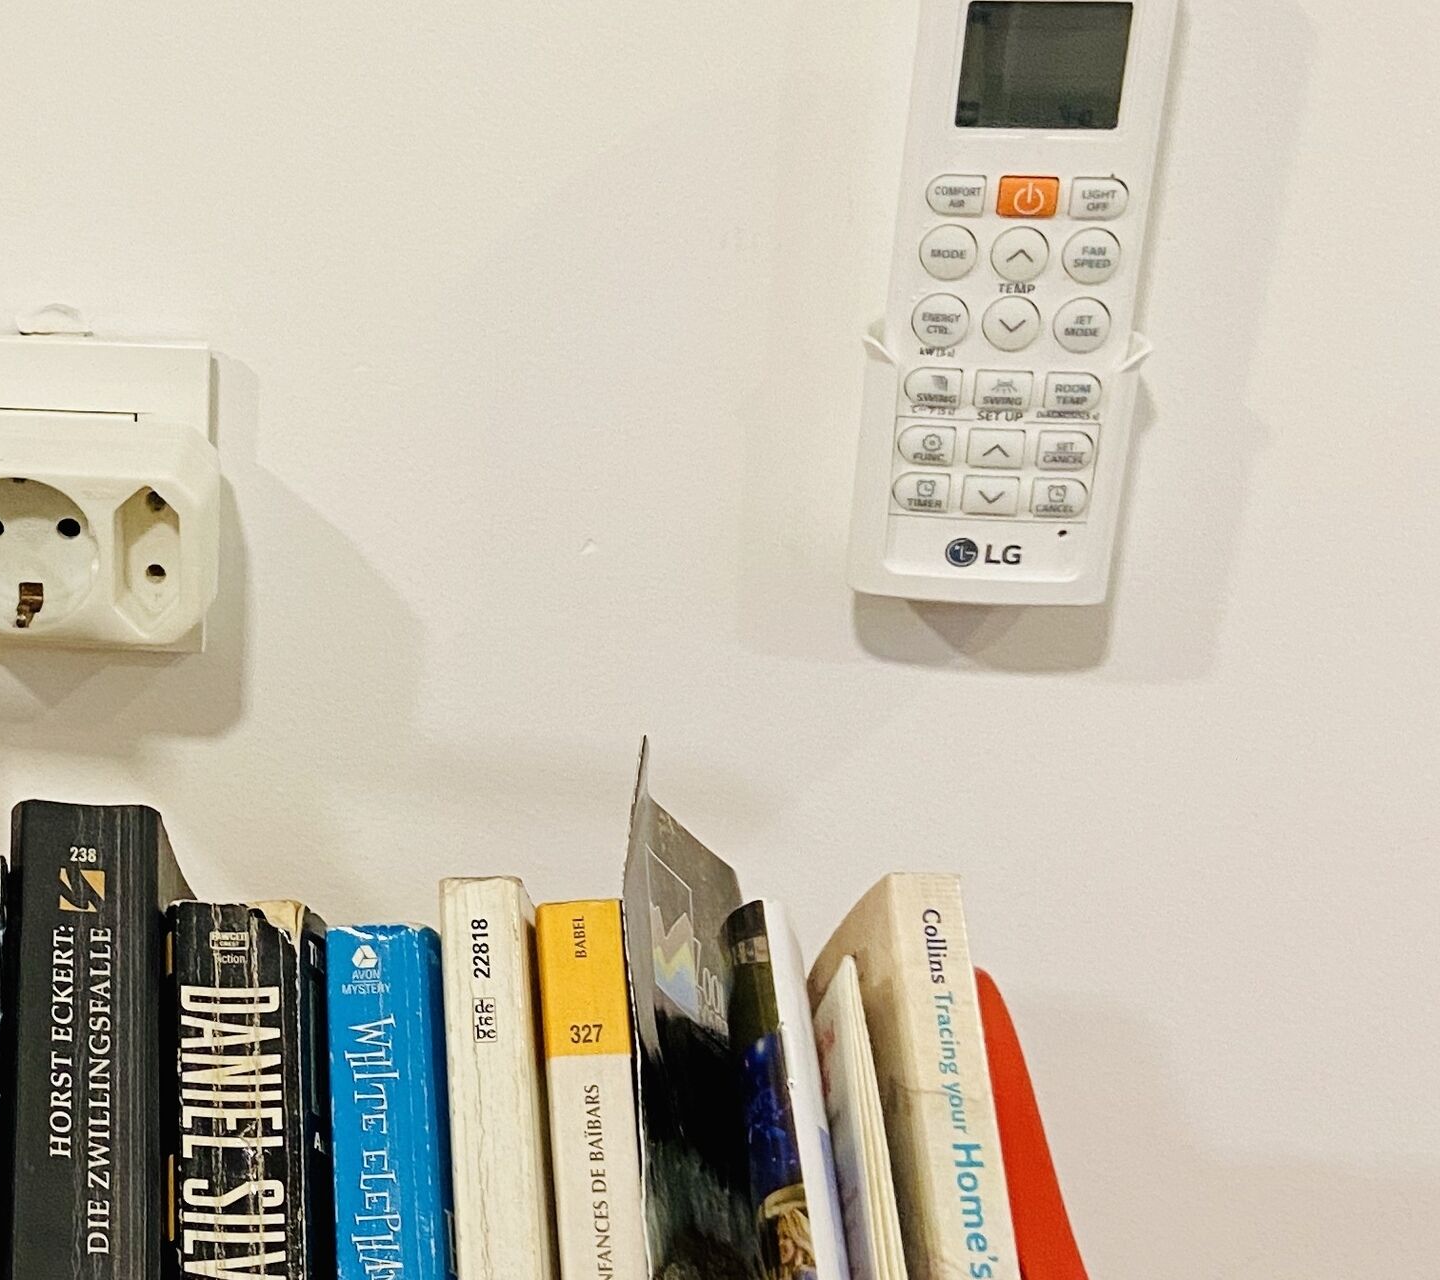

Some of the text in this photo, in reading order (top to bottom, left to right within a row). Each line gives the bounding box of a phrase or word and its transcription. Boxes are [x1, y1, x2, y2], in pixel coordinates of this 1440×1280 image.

[934, 186, 981, 197] COMFORT
[1081, 189, 1117, 199] LIGHT
[1086, 202, 1110, 212] OFF
[930, 249, 967, 259] MODE
[1081, 246, 1107, 256] FAN
[1073, 259, 1112, 269] SPEED
[998, 283, 1036, 294] TEMP
[921, 312, 961, 323] ENERGY
[1074, 315, 1094, 325] JET
[1064, 328, 1100, 337] MODE
[1054, 383, 1092, 394] ROOM
[916, 393, 957, 404] SWING
[982, 395, 1023, 406] SWING
[1055, 396, 1088, 406] TEMP
[976, 411, 1000, 421] SET
[1004, 411, 1024, 422] UP
[906, 498, 943, 509] TIMER
[69, 847, 97, 863] 238
[571, 915, 588, 959] BABEL
[470, 917, 491, 979] 22818
[921, 908, 948, 985] Collins
[351, 969, 382, 980] AVON
[341, 983, 391, 996] MYSTERY
[569, 1024, 604, 1044] 327
[933, 990, 961, 1076] Tracing
[49, 924, 76, 1159] HORST ECKERT:
[179, 984, 285, 1160] DANIEL
[344, 1012, 401, 1135] WHITE
[87, 926, 113, 1256] DIE ZWILLINGSFALLE
[940, 1081, 969, 1134] your
[583, 1083, 606, 1163] BAÏBARS
[590, 1168, 607, 1194] DE
[951, 1142, 1000, 1280] Home's
